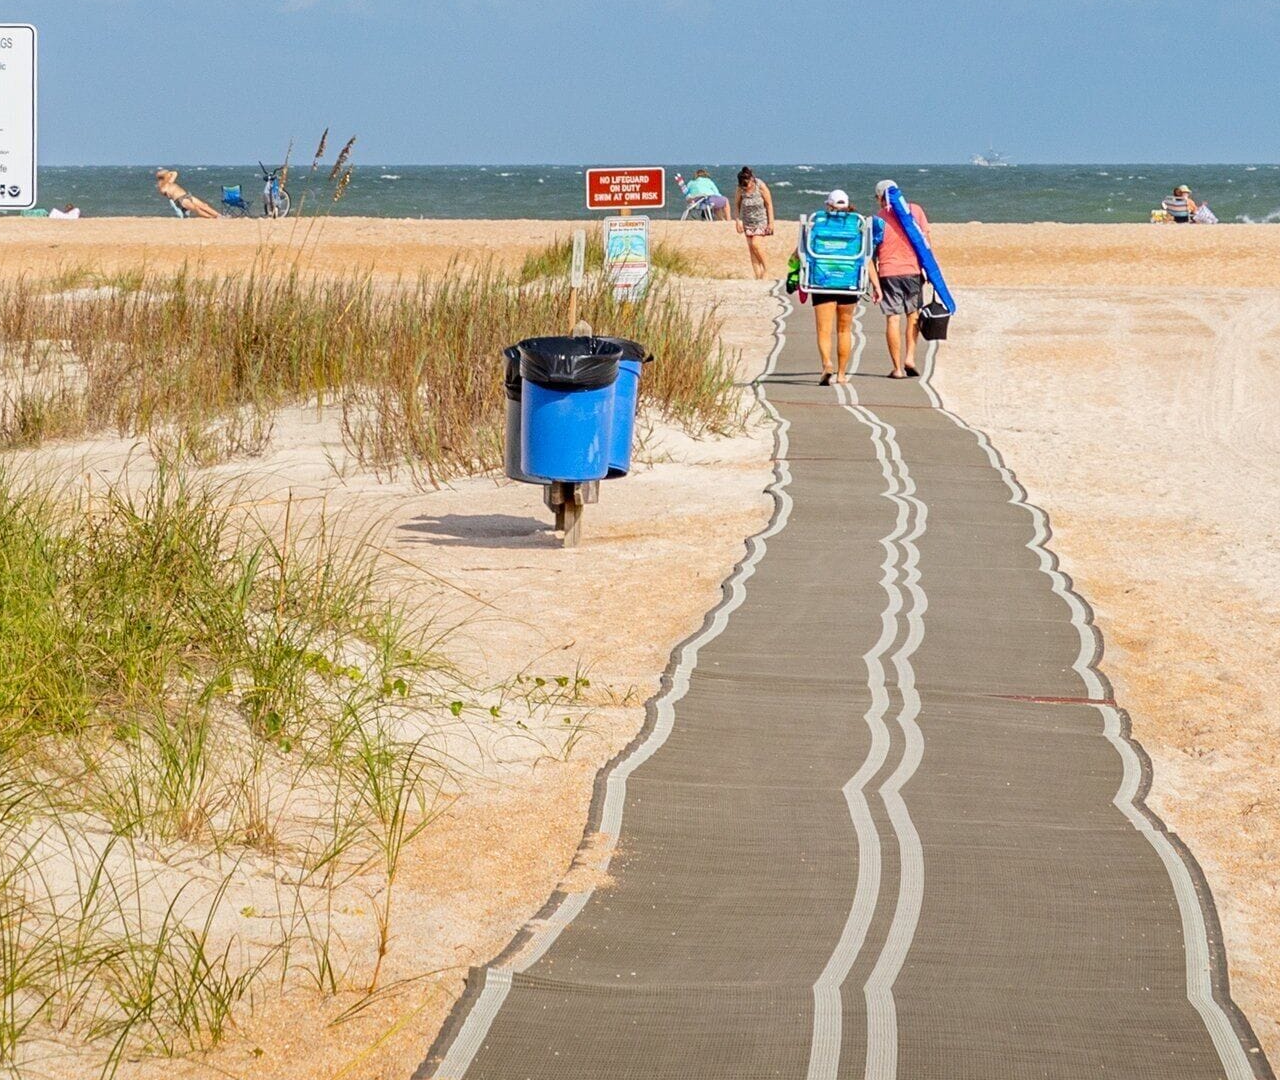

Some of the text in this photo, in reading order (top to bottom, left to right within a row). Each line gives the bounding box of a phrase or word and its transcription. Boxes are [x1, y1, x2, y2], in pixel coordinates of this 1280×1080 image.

[600, 176, 649, 185] NO LIFEGUARD
[610, 185, 621, 193] ON
[594, 192, 658, 202] SWIM AT OWN RISK
